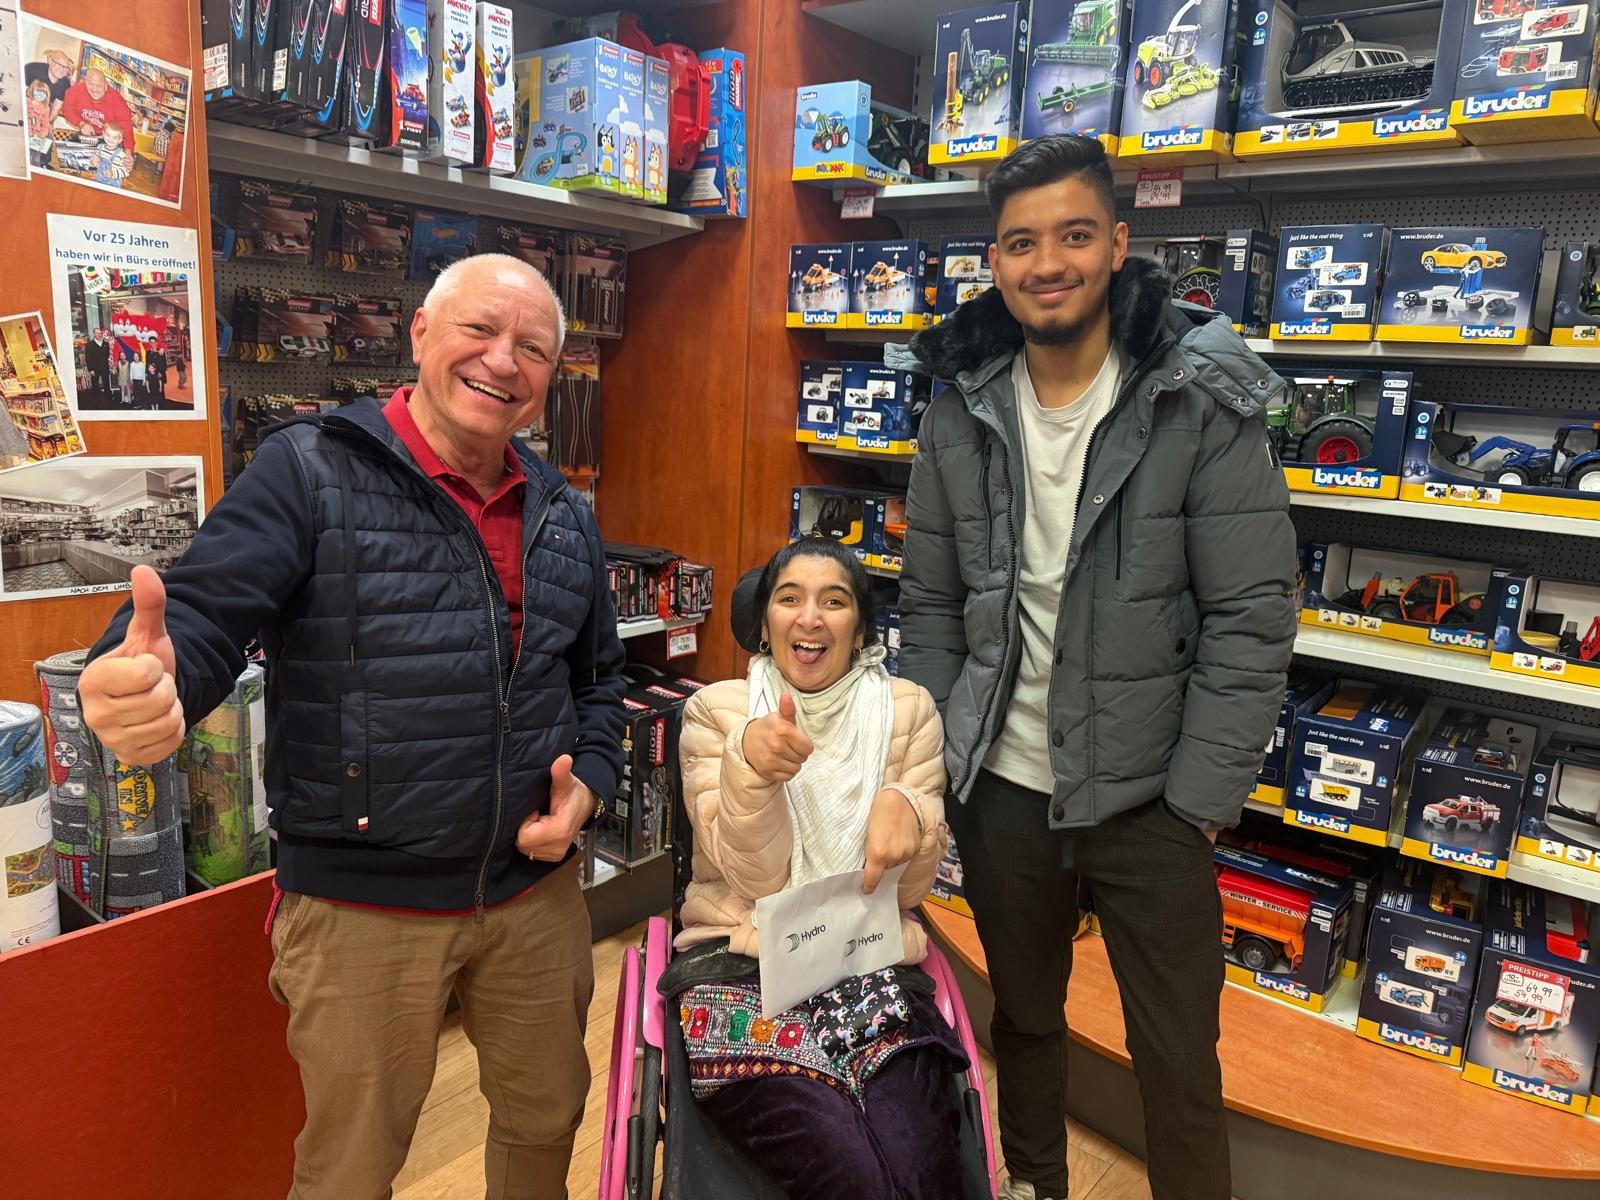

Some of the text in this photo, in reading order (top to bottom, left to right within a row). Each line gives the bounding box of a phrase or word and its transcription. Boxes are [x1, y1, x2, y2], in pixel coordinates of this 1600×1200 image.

[1465, 93, 1547, 114] bruder
[1375, 115, 1444, 134] bruder
[948, 136, 996, 154] bruder
[1143, 131, 1201, 149] bruder
[866, 166, 886, 180] bruder
[83, 230, 169, 248] Vor 25 Jahren
[55, 248, 196, 269] haben wir in Bürs eröffnet!
[803, 311, 836, 323] bruder
[866, 311, 902, 324] bruder
[1280, 322, 1329, 335] bruder
[1461, 327, 1513, 339] bruder
[857, 436, 889, 449] bruder
[1314, 468, 1379, 488] bruder
[1430, 628, 1486, 649] bruder
[1464, 776, 1511, 790] www.bruder.de
[120, 788, 132, 805] IN
[134, 773, 149, 816] DRIVE
[1297, 810, 1348, 833] bruder
[1431, 842, 1494, 869] bruder
[1230, 891, 1257, 904] WINTER
[1262, 902, 1293, 915] SERVICE
[800, 924, 826, 942] Hydro
[857, 932, 883, 947] Hydro
[1425, 929, 1471, 943] www.bruder.de
[1508, 964, 1550, 980] PREISTIPP
[1255, 972, 1310, 1000] bruder
[1381, 1025, 1448, 1055] bruder
[1495, 1070, 1569, 1105] bruder
